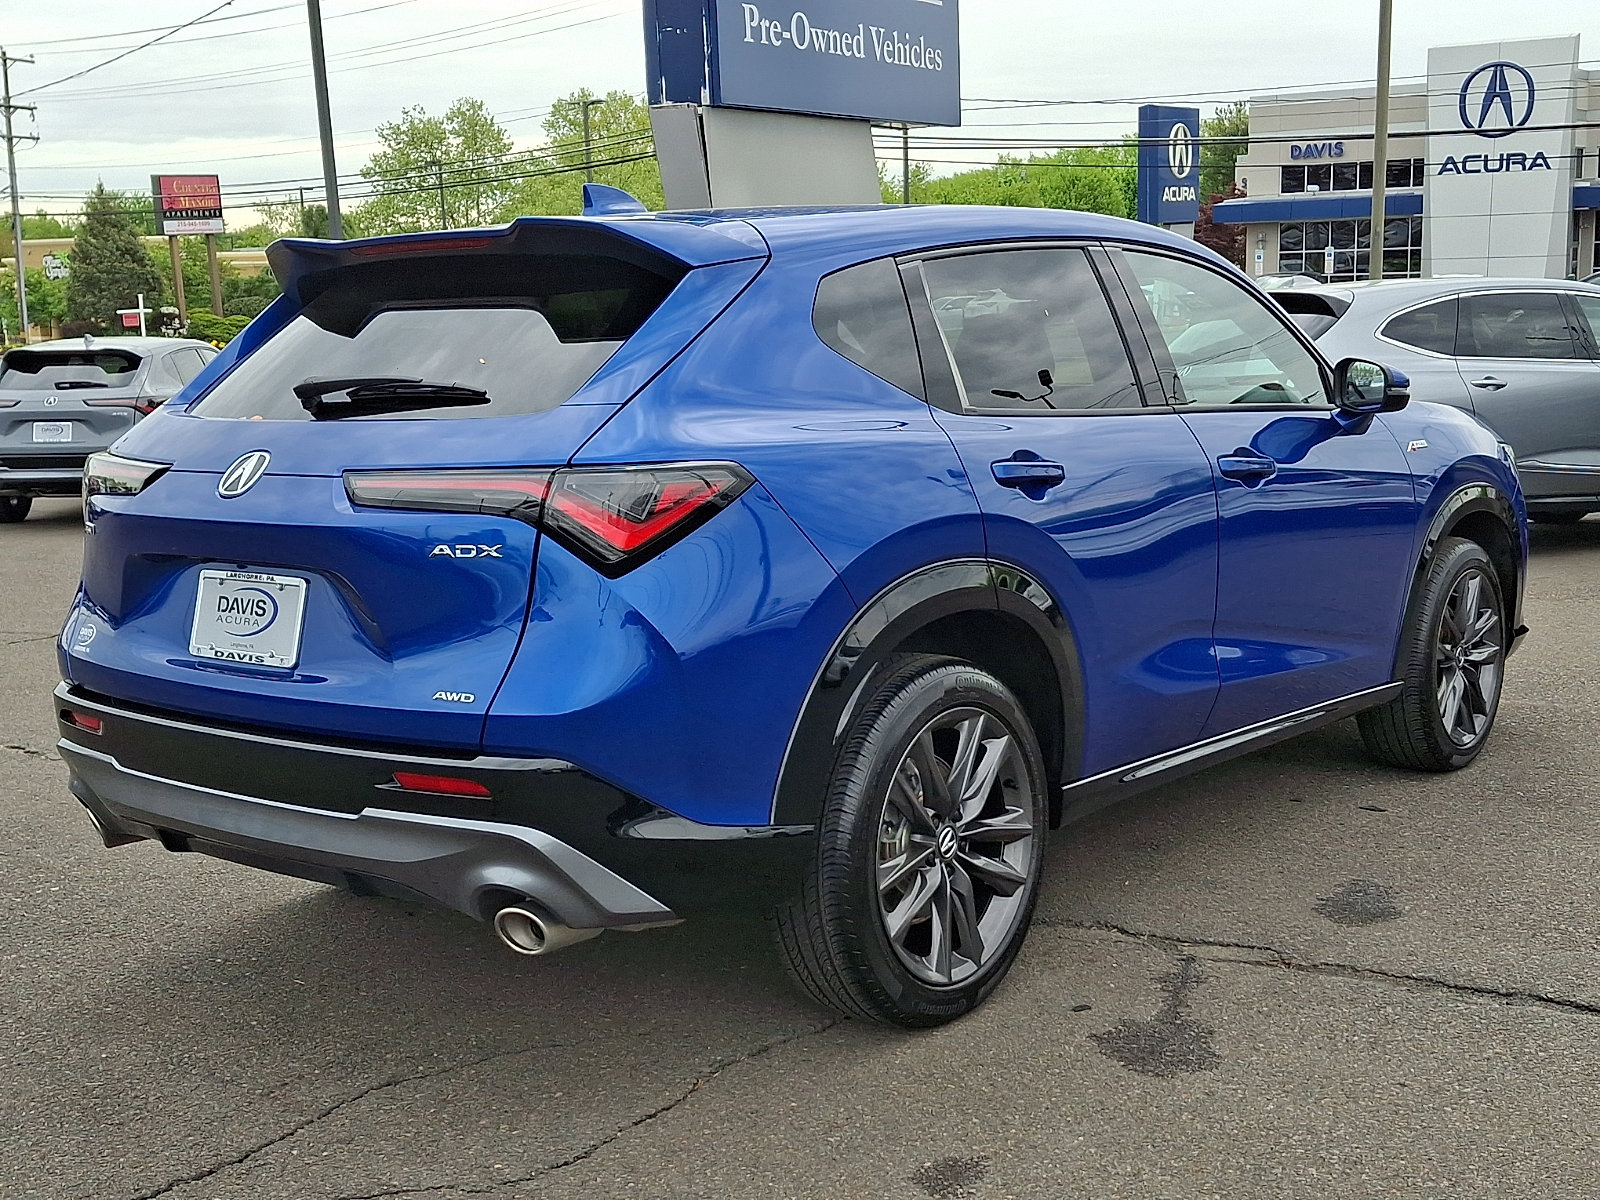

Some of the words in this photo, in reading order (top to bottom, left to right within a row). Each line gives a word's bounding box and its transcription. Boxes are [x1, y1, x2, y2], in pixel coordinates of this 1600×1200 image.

[742, 3, 865, 59] Pre-Owned
[869, 25, 943, 71] Vehicles
[1290, 142, 1344, 160] DAVIS
[1437, 151, 1552, 176] ACURA
[1162, 186, 1197, 202] ACURA
[165, 209, 220, 218] APARTMENTS
[428, 544, 504, 558] ADX
[217, 595, 267, 617] DAVIS
[215, 614, 260, 628] ACURA
[213, 650, 266, 663] DAVIS
[432, 691, 475, 703] AWD
